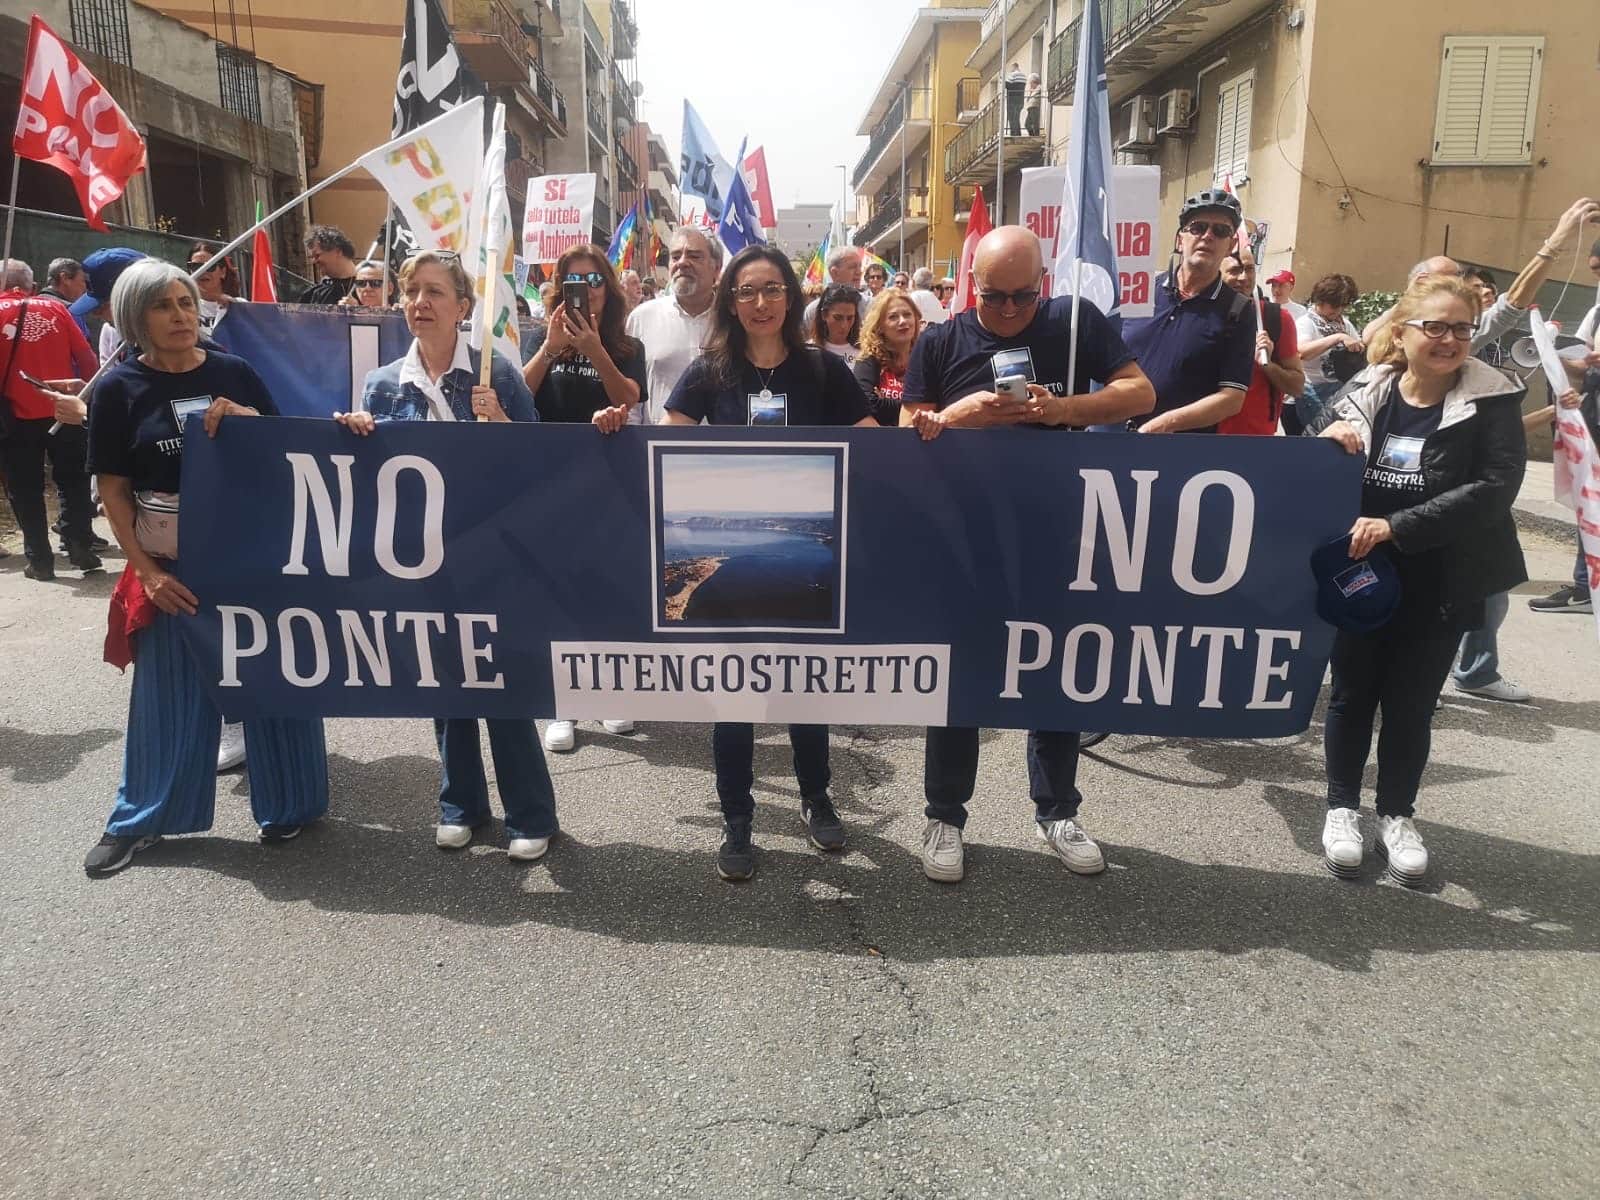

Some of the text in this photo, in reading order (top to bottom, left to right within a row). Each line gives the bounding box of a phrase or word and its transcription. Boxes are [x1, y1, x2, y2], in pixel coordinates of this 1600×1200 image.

[544, 206, 580, 225] tutela
[282, 452, 445, 580] NO
[1068, 468, 1255, 595] NO
[216, 605, 505, 690] PONTE
[561, 653, 938, 694] TITENGOSTRETTO
[1000, 620, 1301, 710] PONTE
